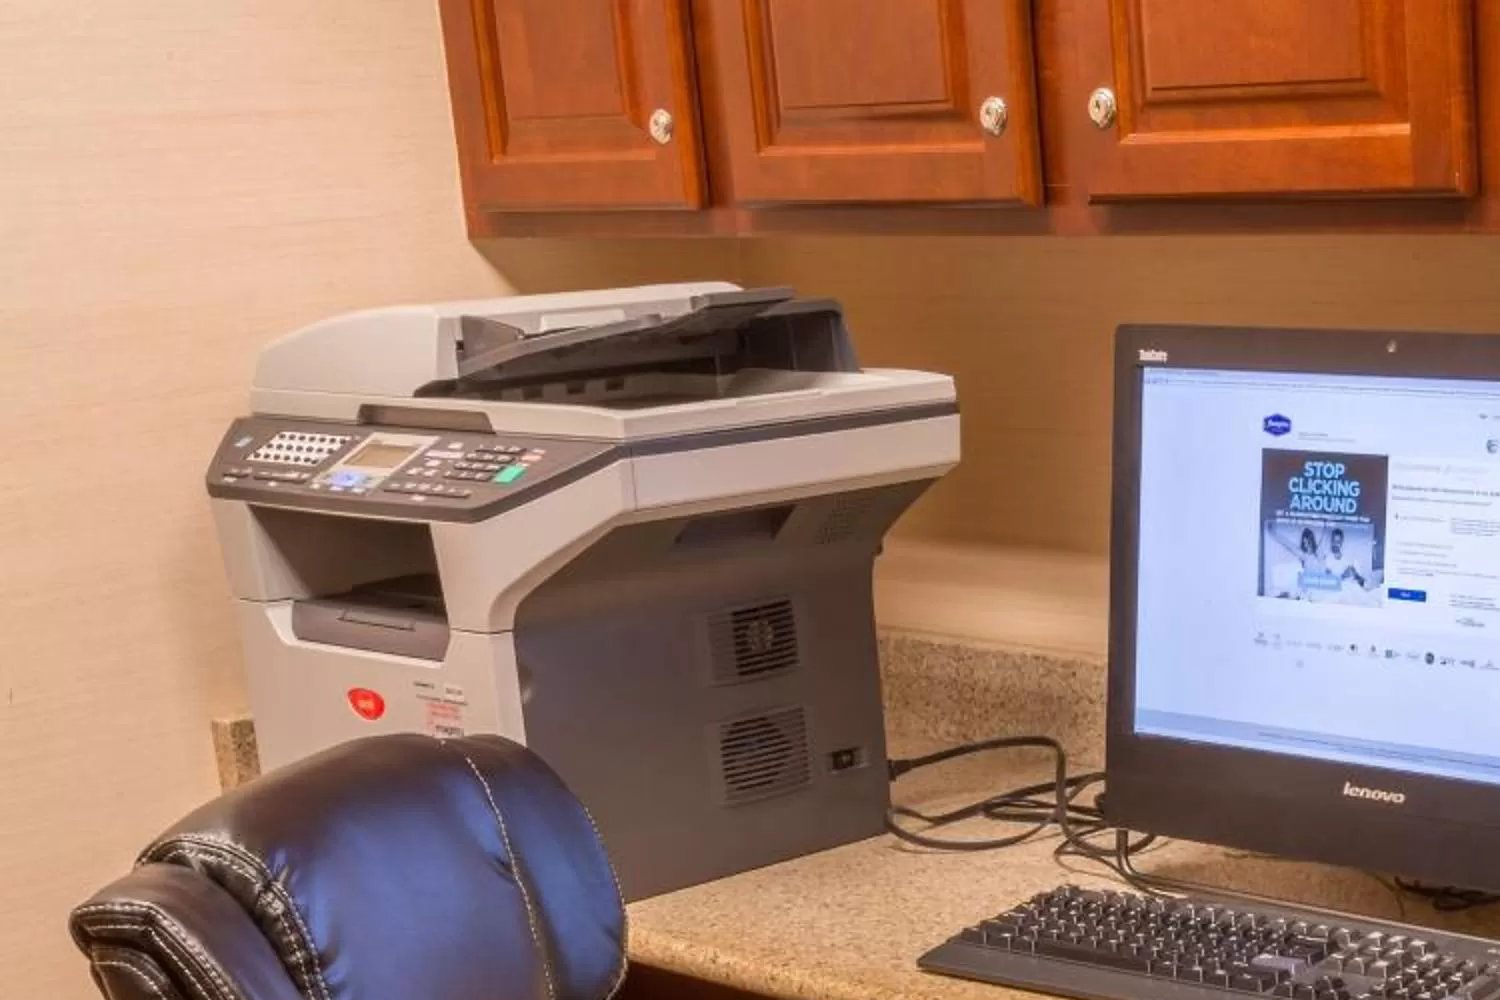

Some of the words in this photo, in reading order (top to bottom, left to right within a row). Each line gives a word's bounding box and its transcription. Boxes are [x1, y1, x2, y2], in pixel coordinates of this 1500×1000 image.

[1303, 461, 1345, 479] STOP
[1288, 477, 1361, 497] CLICKING
[1289, 495, 1358, 513] AROUND
[1343, 781, 1405, 803] lenovo
